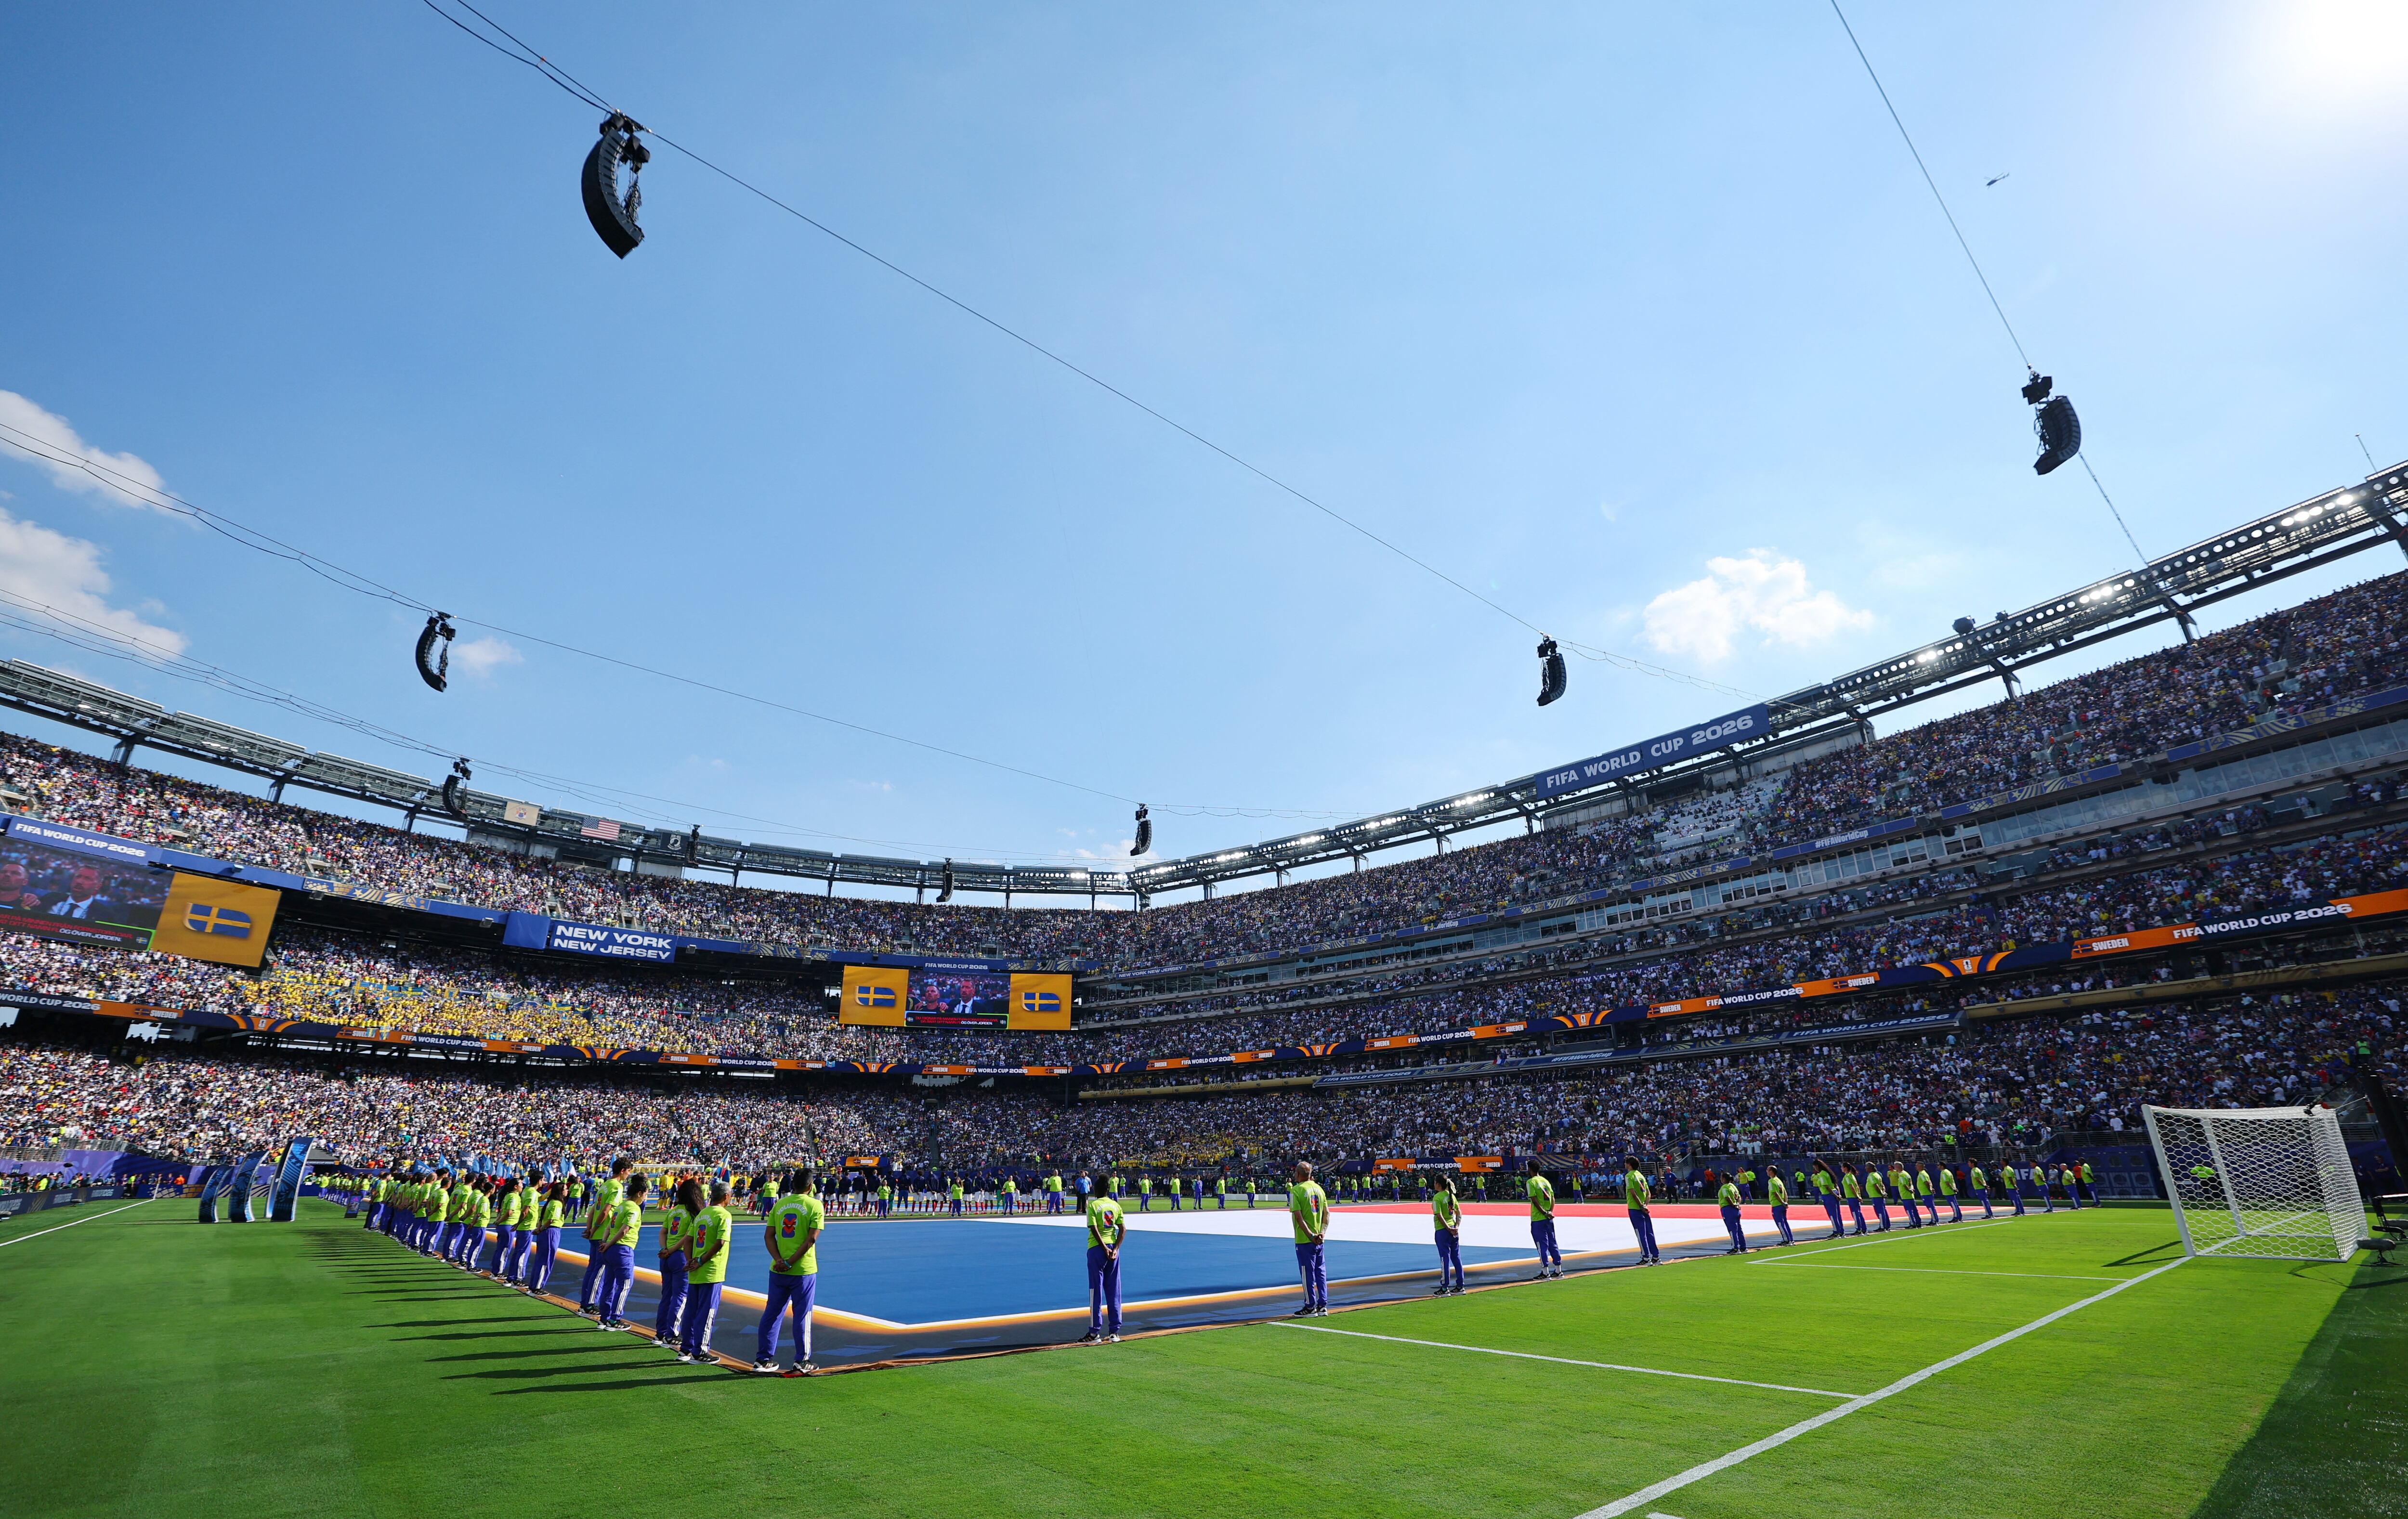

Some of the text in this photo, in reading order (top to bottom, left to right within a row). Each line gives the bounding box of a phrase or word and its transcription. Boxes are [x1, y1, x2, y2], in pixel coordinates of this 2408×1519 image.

[1547, 715, 1754, 789] FIFA WORLD CUP 2026
[15, 823, 146, 857] FIFA WORLD CUP 2026
[1815, 830, 1869, 848] #FIFAWorldCup
[2172, 904, 2353, 939] FIFA WORLD CUP 2026
[556, 925, 672, 948] NEW YORK
[2092, 937, 2130, 951] SWEDEN
[553, 938, 671, 959] NEW JERSEY
[1847, 976, 1875, 987] SWEDEN
[0, 993, 101, 1011] WORLD CUP 2026
[1706, 987, 1804, 1007] FIFA WORLD CUP 2026
[150, 1010, 178, 1019] SWEDEN
[1660, 1004, 1681, 1013] SWEDEN
[1822, 1024, 1868, 1033] WORLD
[1898, 1014, 1950, 1024] 2026
[418, 1036, 445, 1045] WORLD
[776, 1203, 808, 1215] VOLUNTEER
